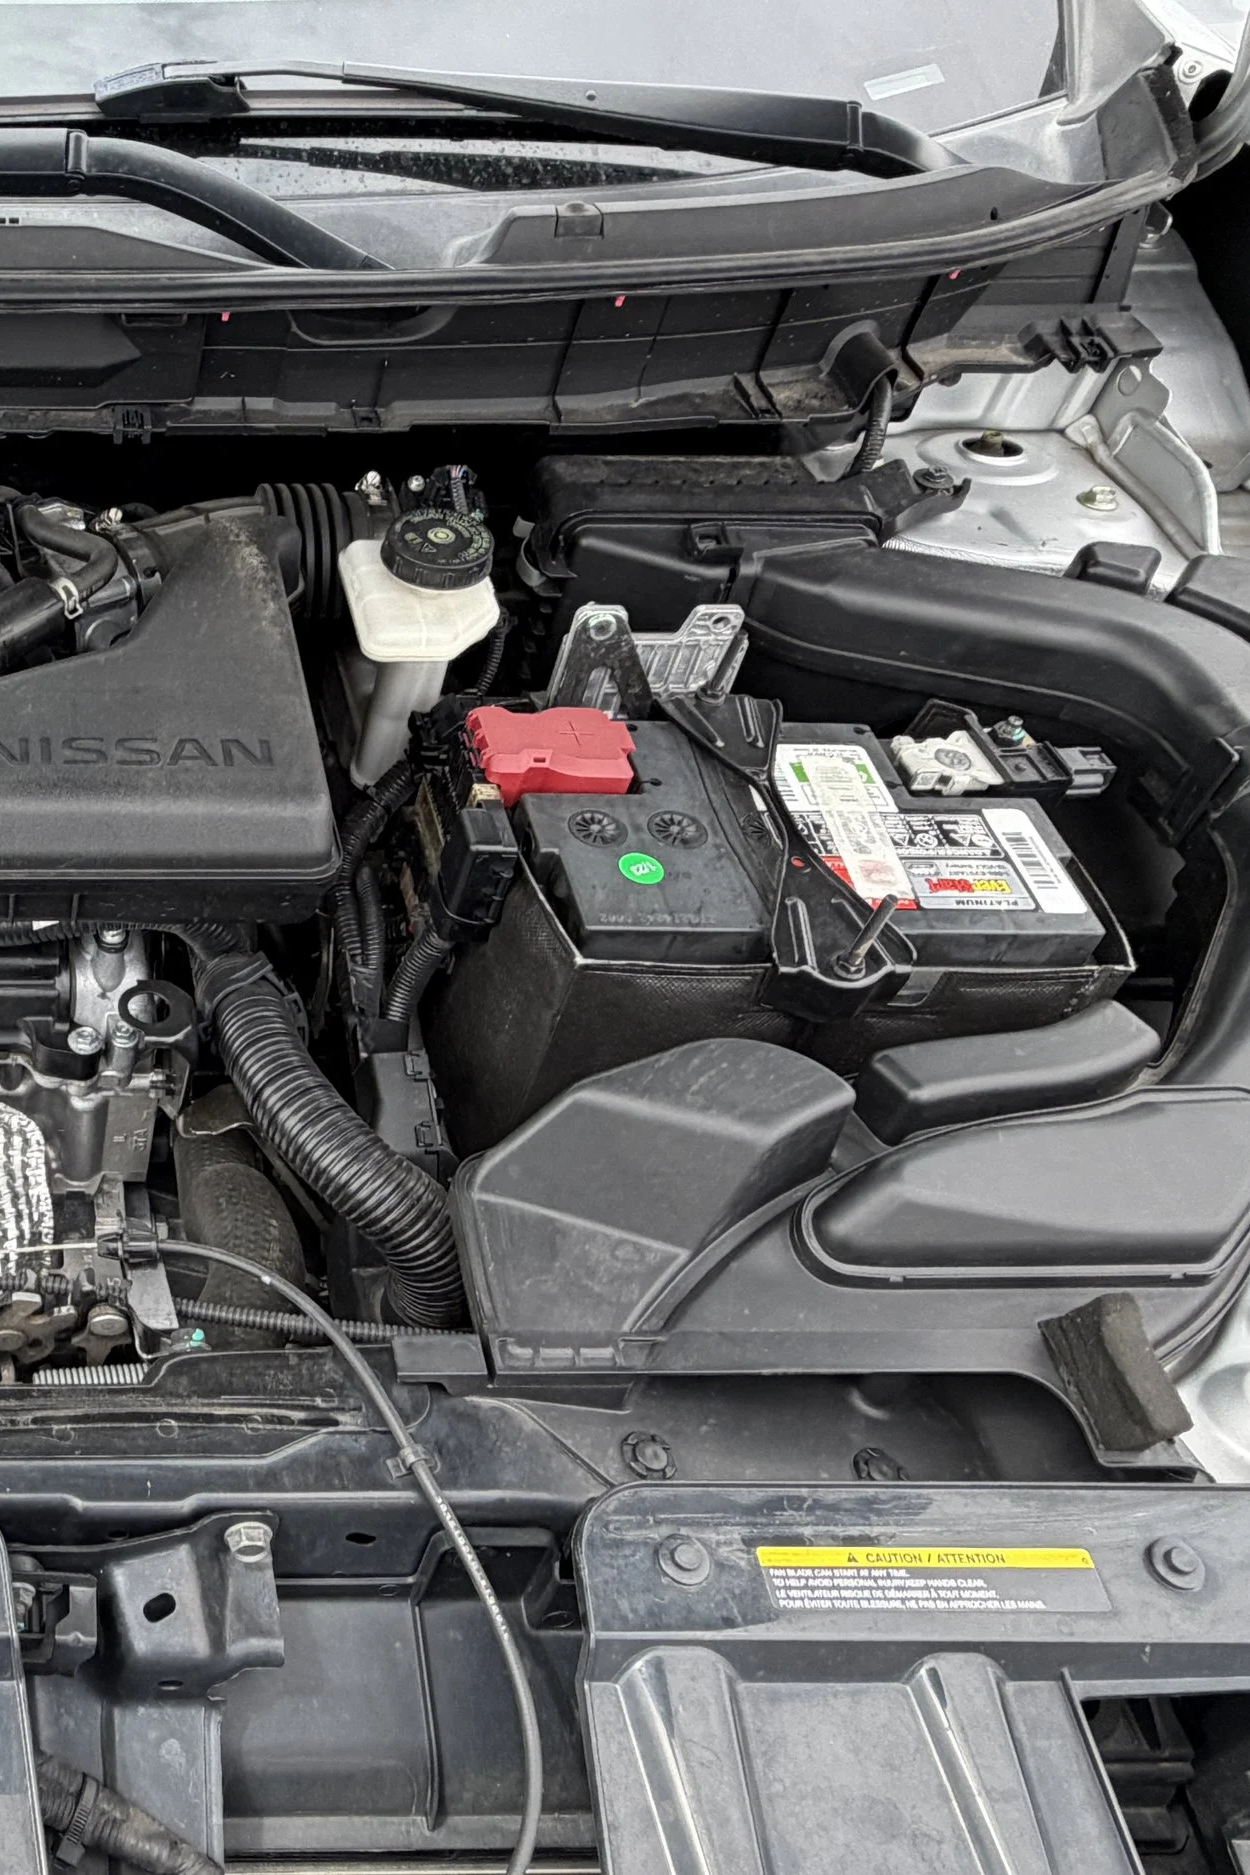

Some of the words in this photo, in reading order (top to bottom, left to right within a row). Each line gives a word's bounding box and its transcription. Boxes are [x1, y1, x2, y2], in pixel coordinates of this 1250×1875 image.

[954, 898, 1020, 907] PLATINUM
[865, 1552, 923, 1564] CAUTION
[937, 1552, 1006, 1564] ATTENTION
[814, 1568, 833, 1577] CAN
[772, 1578, 785, 1587] TO
[786, 1578, 807, 1587] HELP
[833, 1578, 877, 1587] PERSONAL
[927, 1578, 957, 1587] HANDS
[918, 1600, 936, 1609] PAS
[949, 1600, 1001, 1609] APPROCHER
[1001, 1600, 1017, 1609] LES
